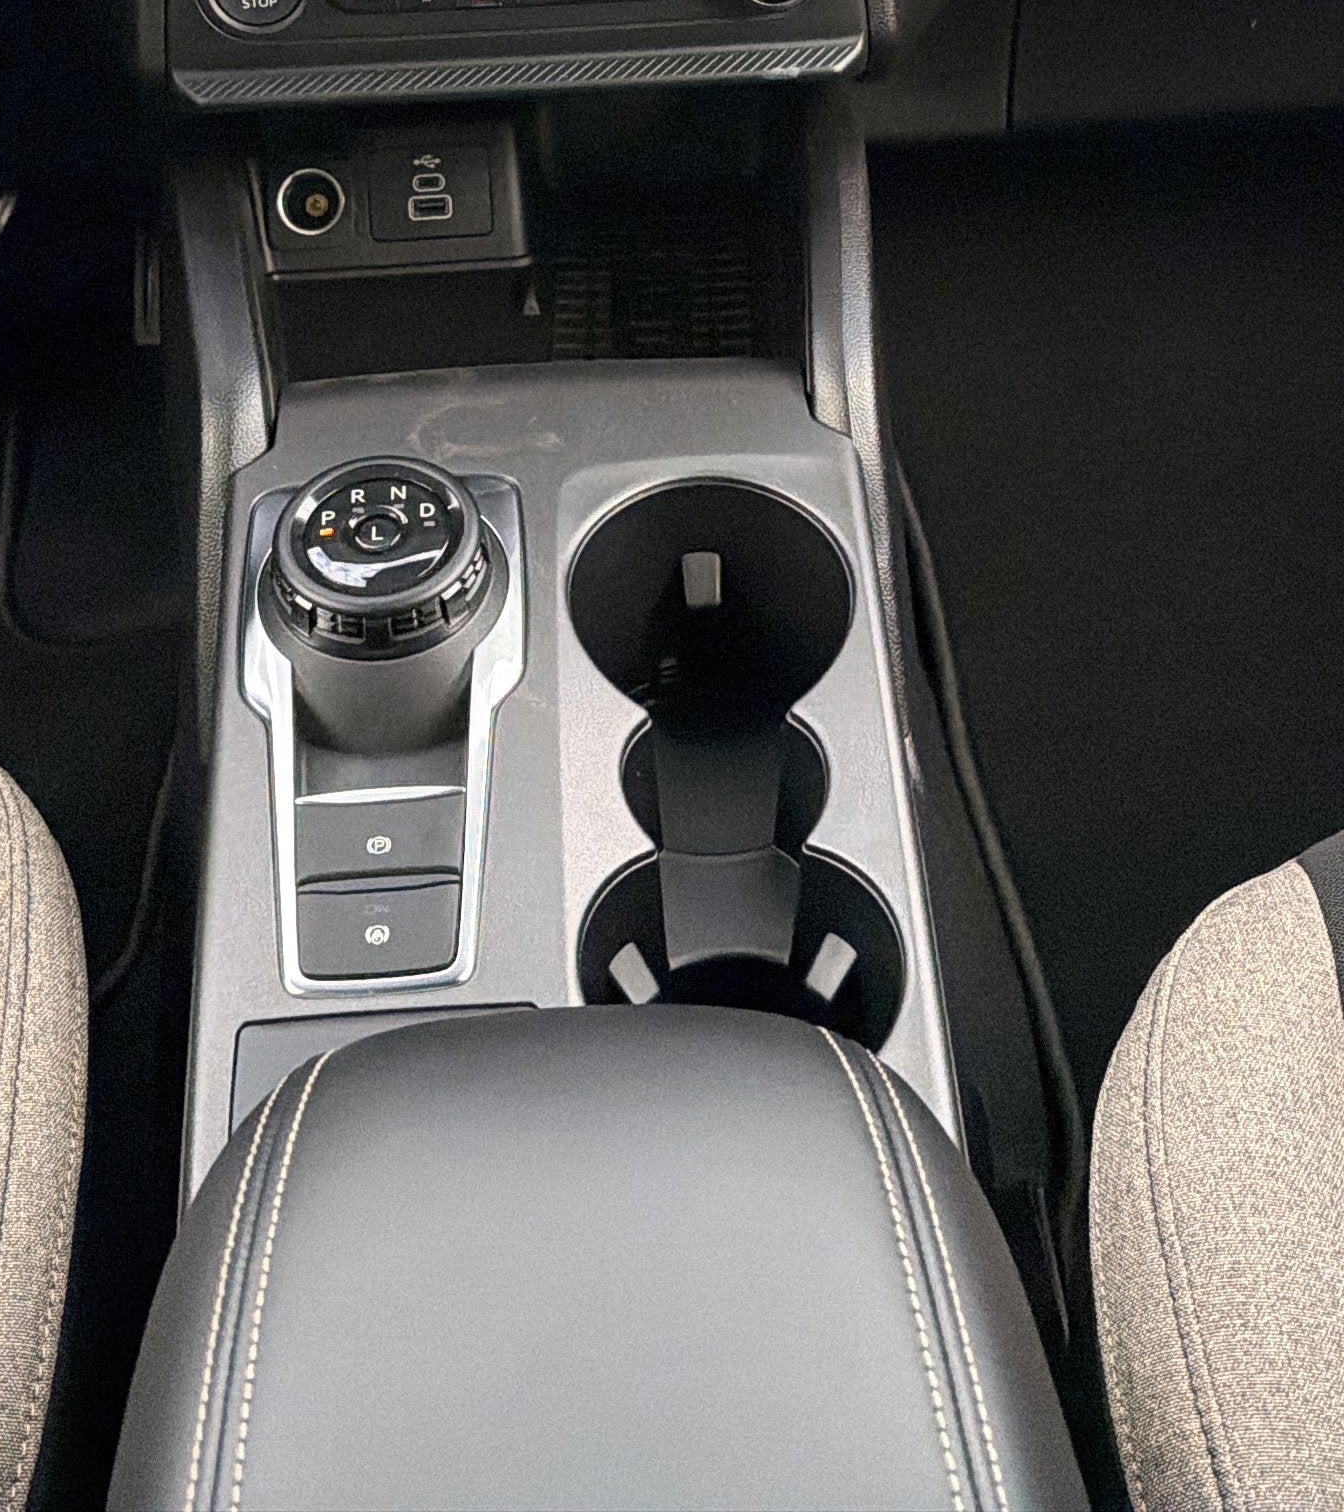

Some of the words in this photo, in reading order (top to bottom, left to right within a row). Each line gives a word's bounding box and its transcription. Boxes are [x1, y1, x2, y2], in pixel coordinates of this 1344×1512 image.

[350, 489, 365, 504] R
[389, 485, 407, 500] N
[321, 510, 337, 526] P
[419, 503, 436, 518] D
[371, 525, 384, 541] L
